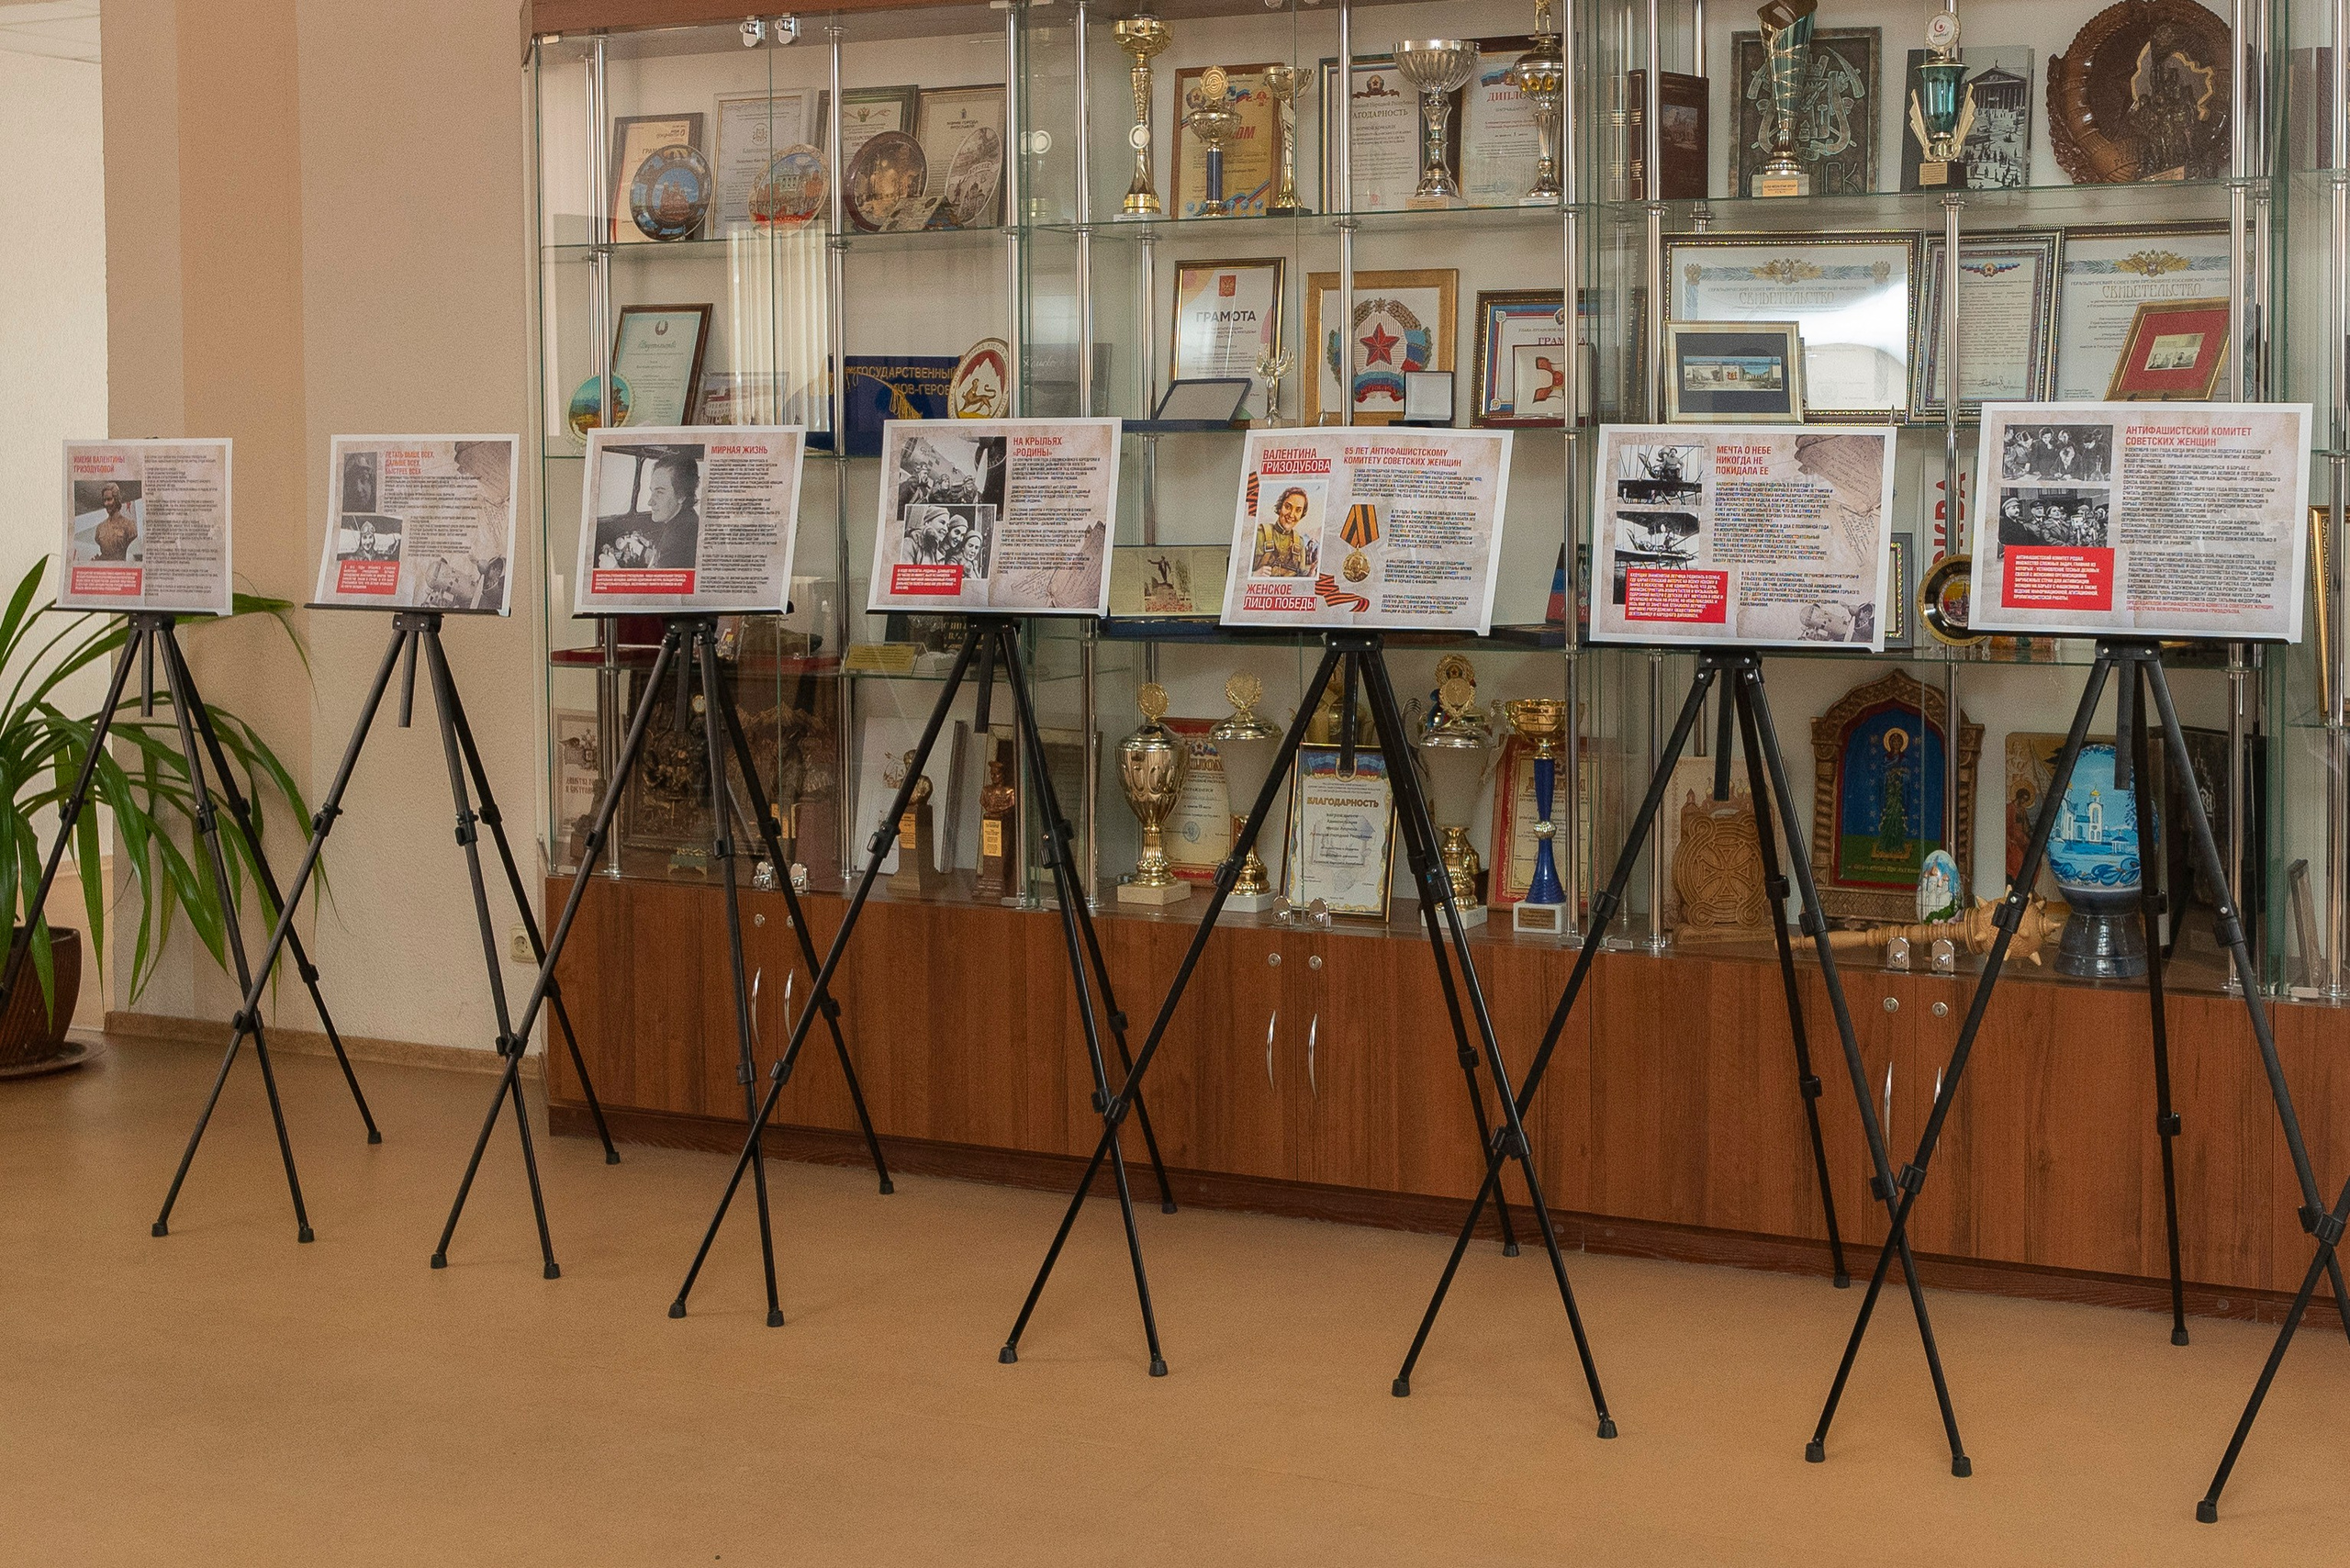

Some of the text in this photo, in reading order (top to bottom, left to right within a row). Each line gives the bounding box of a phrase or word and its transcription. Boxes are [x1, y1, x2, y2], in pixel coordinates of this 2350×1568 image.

[1487, 92, 1527, 101] ДИПЛО
[2102, 284, 2201, 298] СВИДЕТЕЛЬСТВО
[1739, 292, 1835, 305] СВИДЕТЕЛЬСТВО
[1196, 310, 1256, 322] ГРАМОТА
[2126, 425, 2252, 436] АНТИФАШИСТСКИЙ КОМИТЕТ
[1013, 436, 1062, 446] НА КРЫЛЬЯХ
[2126, 437, 2216, 446] СОВЕТСКИХ ЖЕНЩИН
[711, 446, 767, 455] МИРНАЯ ЖИЗНЬ
[1012, 448, 1053, 457] «РОДИНЫ»
[1263, 448, 1316, 459] ВАЛЕНТИНА
[1344, 447, 1449, 457] 85 ЛЕТ АНТИФАШИСТСКОМУ
[1717, 446, 1772, 455] МЕЧТА О НЕБЕ
[73, 455, 125, 465] ИМЕНИ ВАЛЕНТИНЫ
[1344, 456, 1461, 468] КОМИТЕТУ СОВЕТСКИХ ЖЕНЩИН
[1716, 455, 1763, 466] НИКОГДА НЕ
[73, 465, 114, 474] ГРИЗОДУБОВОЙ
[409, 467, 421, 476] ВСЕХ
[1262, 459, 1331, 474] ГРИЗОДУБОВА
[1716, 465, 1770, 476] ПОКИДАЛА ЕЕ
[1247, 584, 1292, 595] ЖЕНСКОЕ
[1244, 597, 1316, 610] ЛИЦО ПОБЕДЫ
[1307, 797, 1379, 808] БЛАГОДАРНОСТЬ
